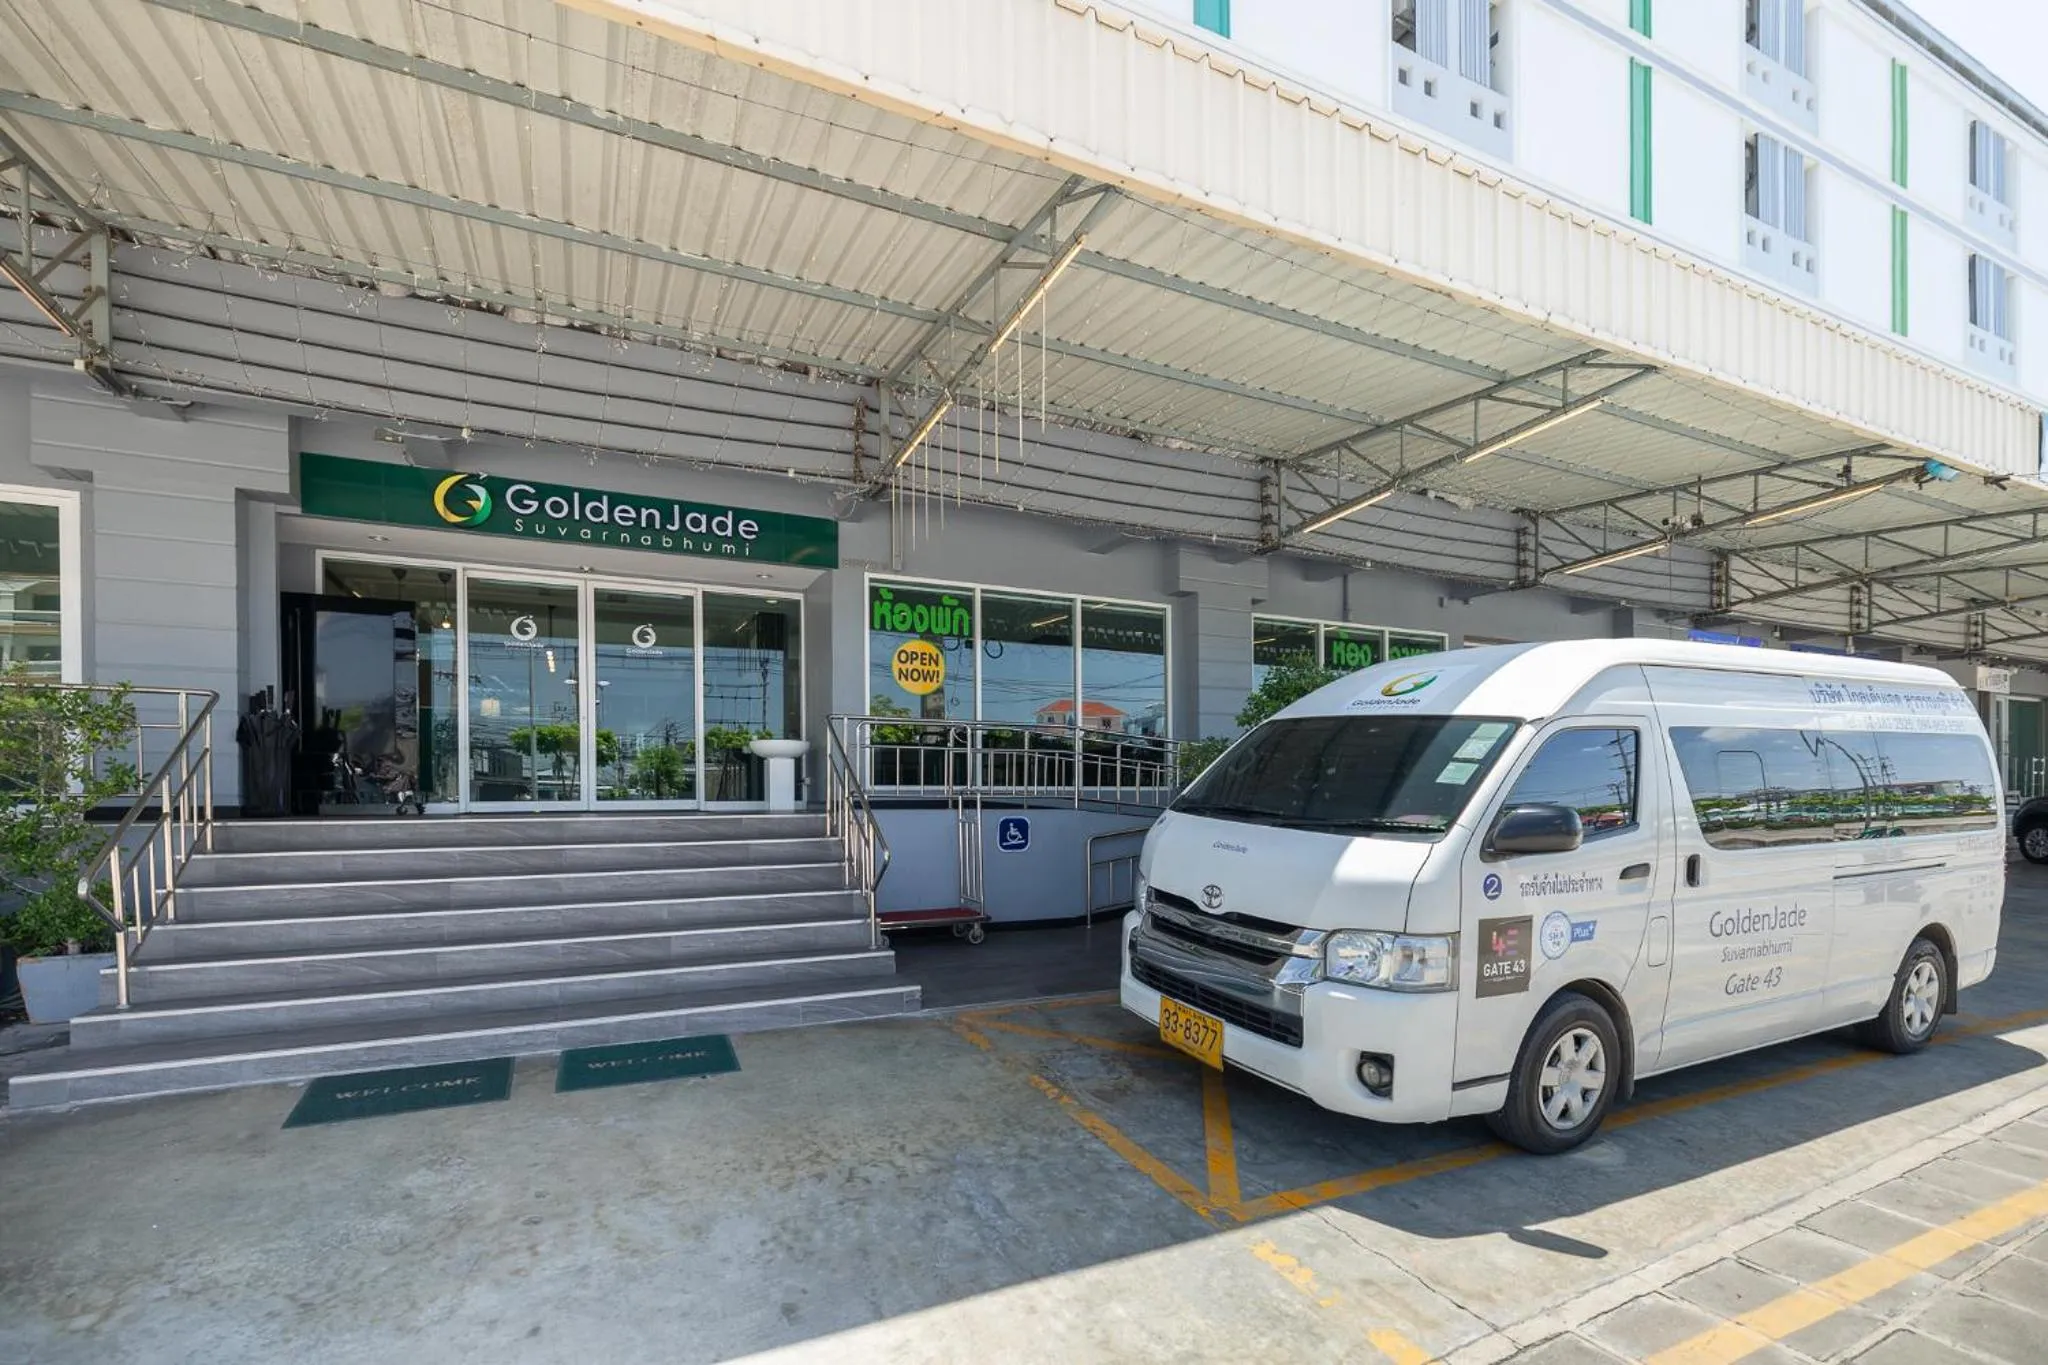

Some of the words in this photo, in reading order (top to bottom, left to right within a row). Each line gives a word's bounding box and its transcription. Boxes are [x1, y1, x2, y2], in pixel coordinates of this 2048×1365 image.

[505, 483, 759, 541] GoldenJade
[513, 518, 752, 556] Suvarnabhumi
[872, 586, 970, 637] ห้องพัก
[896, 649, 939, 668] OPEN
[897, 666, 940, 684] NOW!
[1486, 877, 1500, 897] 2
[1709, 902, 1807, 938] GoldenJade
[1721, 938, 1794, 963] Suvarnabhumi
[1483, 960, 1511, 977] GATE
[1512, 959, 1526, 973] 43
[1725, 973, 1760, 996] Gate
[1763, 966, 1783, 989] 43
[1162, 1006, 1219, 1052] 33-8377
